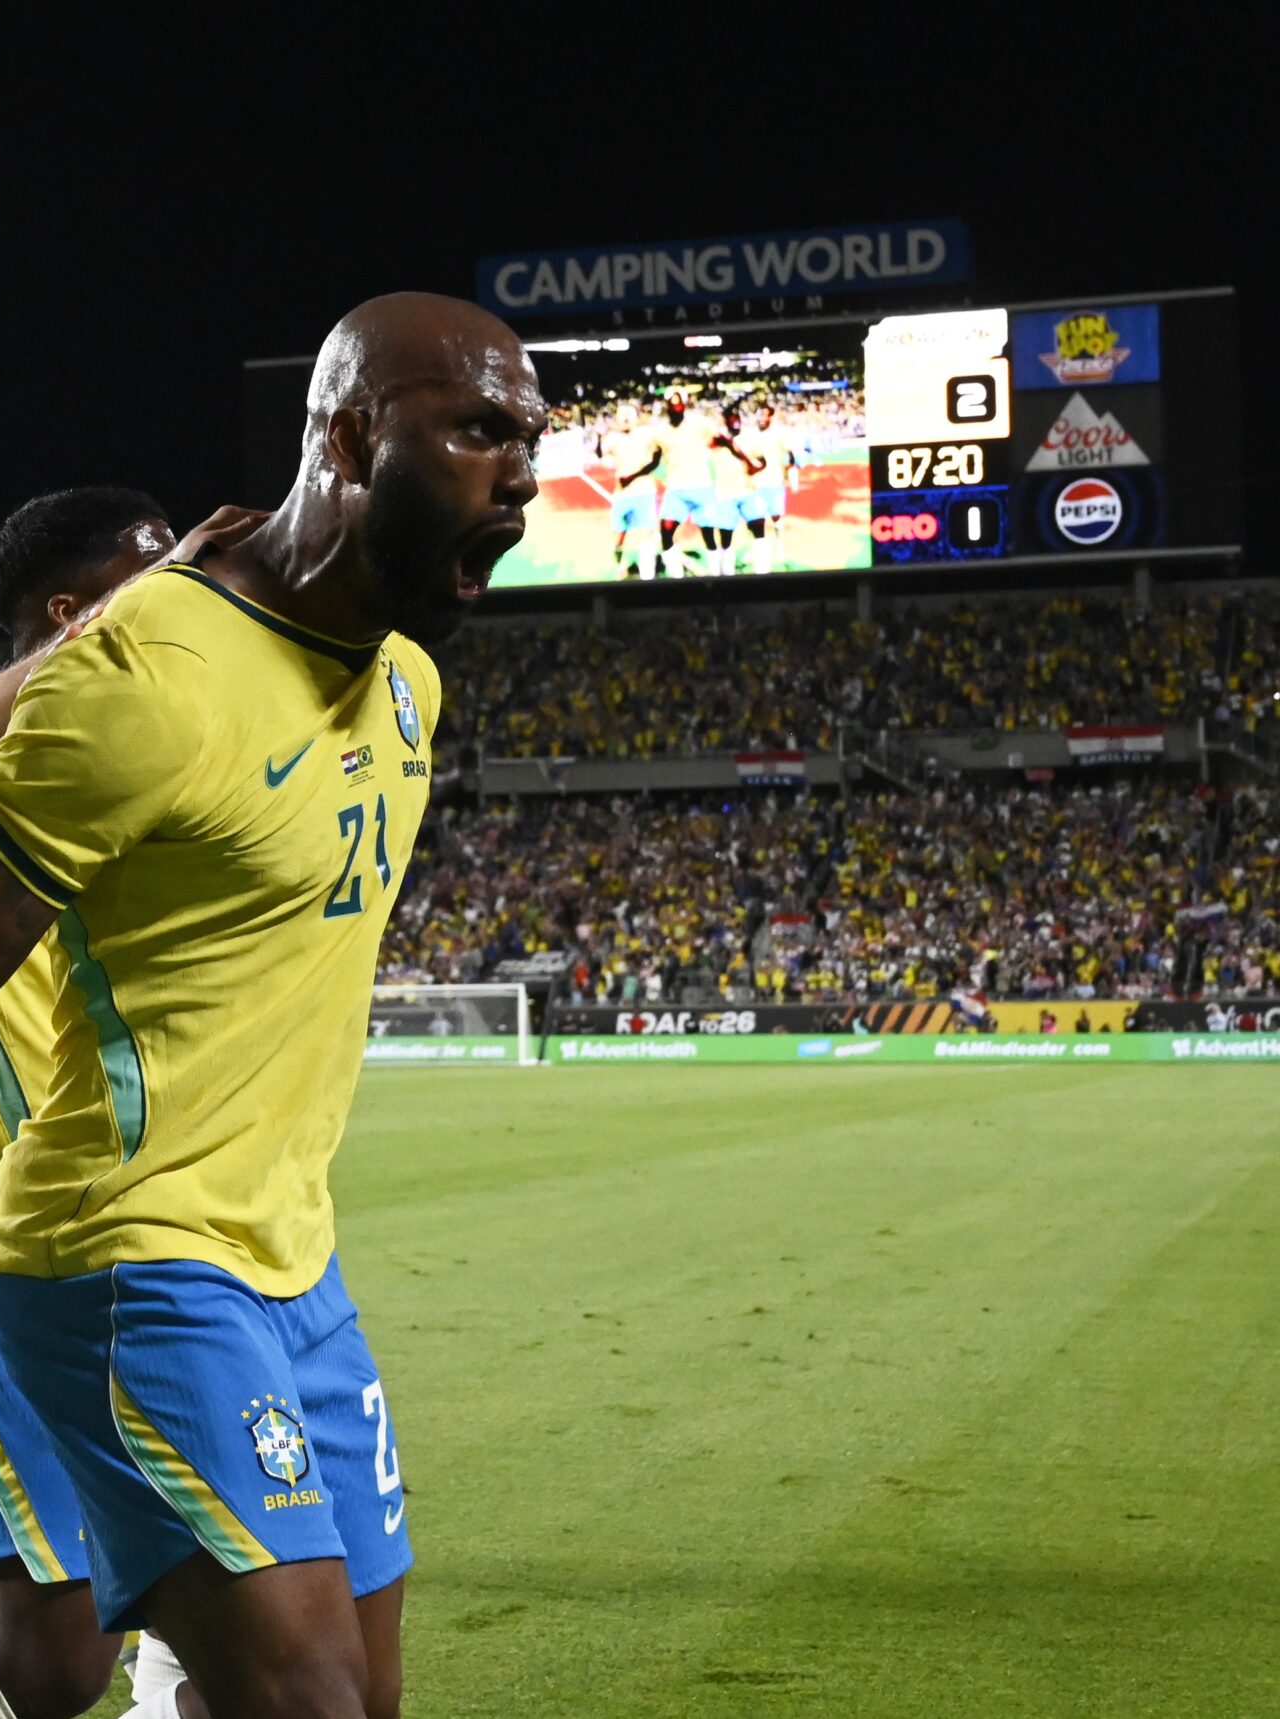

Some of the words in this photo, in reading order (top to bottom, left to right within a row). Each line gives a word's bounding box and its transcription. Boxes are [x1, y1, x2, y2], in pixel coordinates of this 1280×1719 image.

[494, 245, 734, 307] CAMPING
[743, 228, 947, 288] WORLD
[612, 294, 824, 325] STADIUM
[956, 383, 987, 417] 2
[1042, 417, 1133, 450] Coors
[1057, 447, 1114, 466] LIGHT
[967, 506, 981, 541] 1
[1061, 504, 1116, 518] PEPSI
[871, 513, 938, 542] CRO
[323, 792, 392, 919] 21
[719, 1010, 757, 1034] 26
[580, 1041, 697, 1058] AdventHealth
[361, 1378, 401, 1496] 2
[263, 1489, 324, 1511] BRASIL
